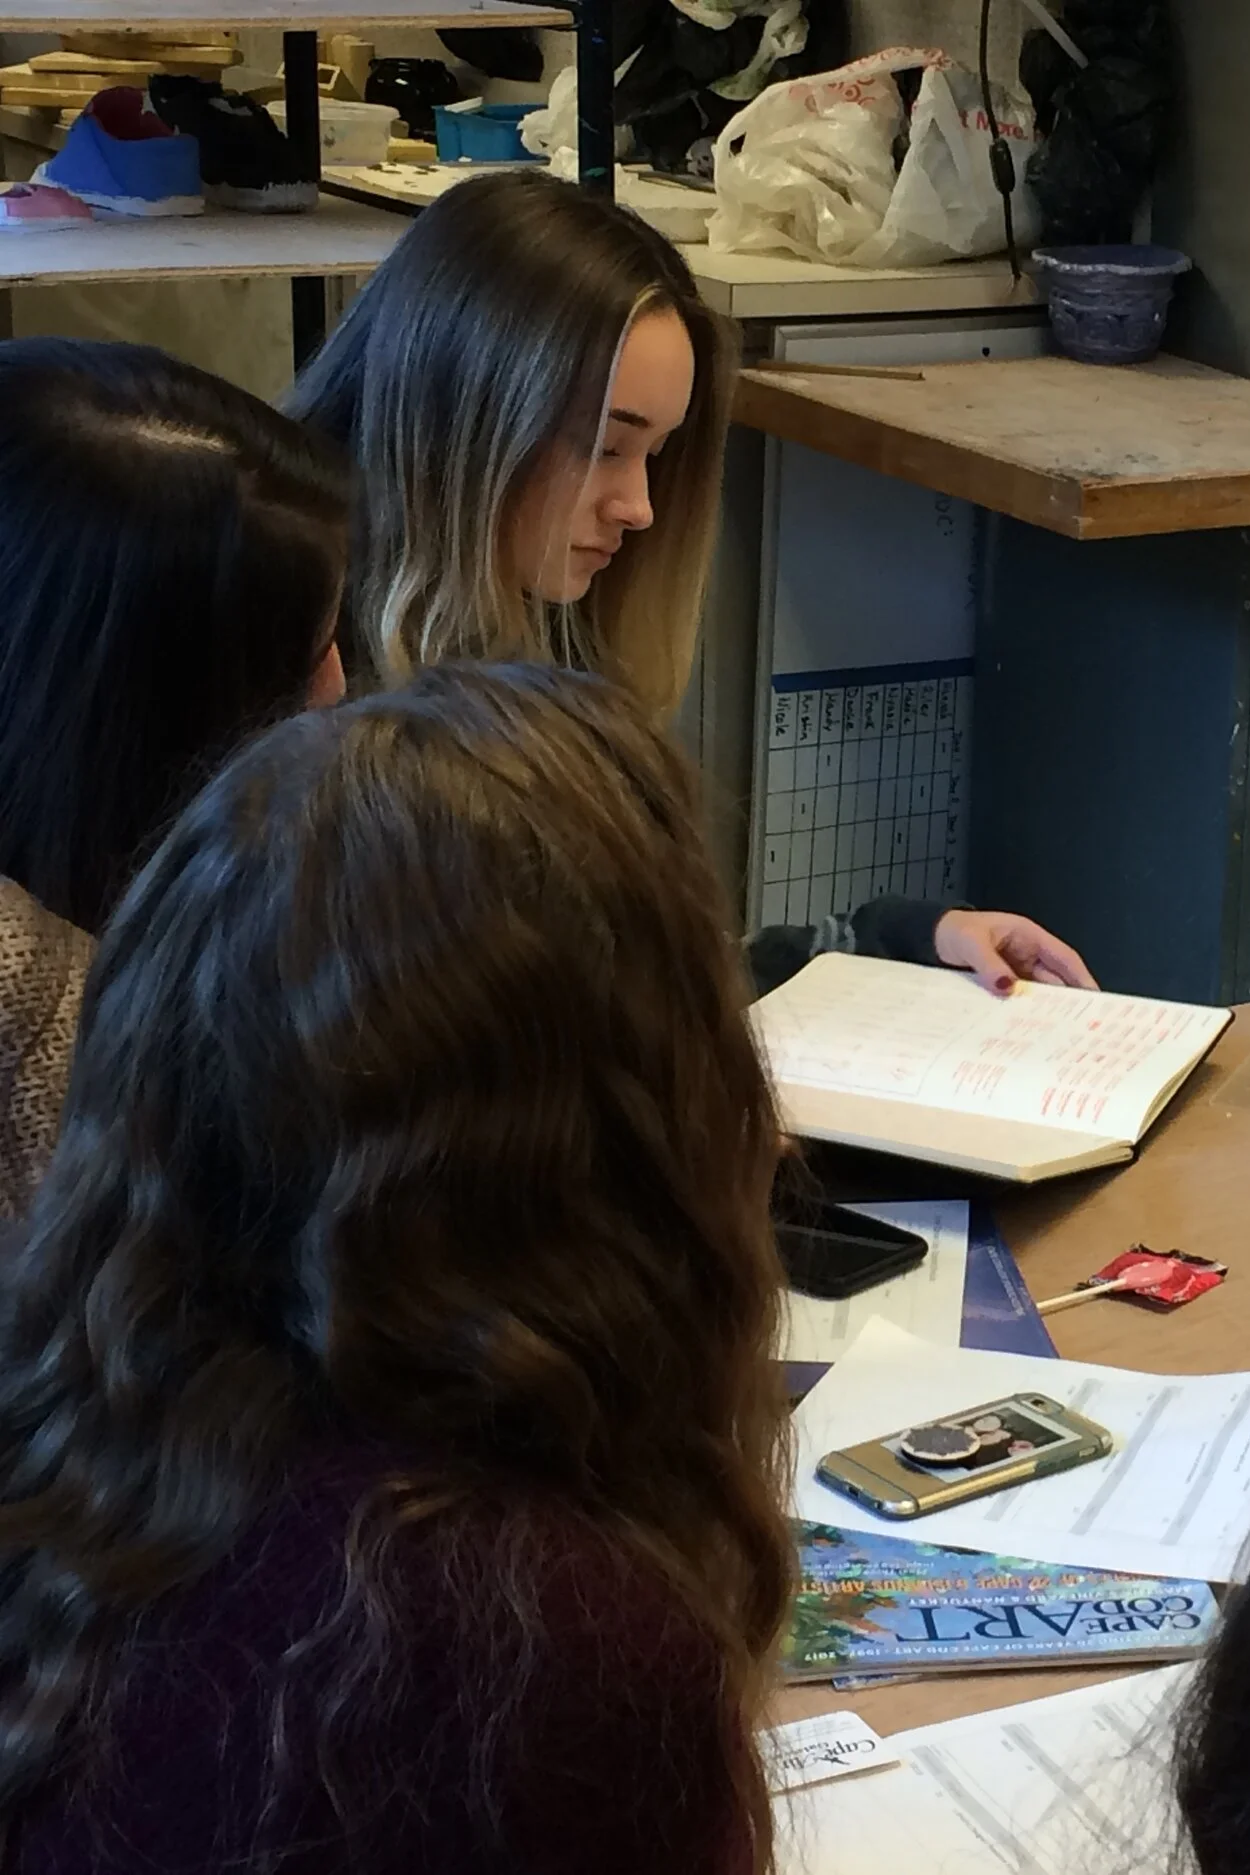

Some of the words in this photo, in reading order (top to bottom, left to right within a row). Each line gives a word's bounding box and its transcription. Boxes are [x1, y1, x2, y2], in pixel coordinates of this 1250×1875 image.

[976, 111, 1029, 140] Mre.
[775, 697, 790, 737] Nicole
[908, 1596, 1006, 1607] NANTUCKET
[1093, 1596, 1193, 1616] COD
[895, 1600, 1091, 1642] ART
[1079, 1614, 1201, 1635] CAPE
[895, 1647, 922, 1655] ART
[926, 1646, 959, 1655] COD
[963, 1644, 999, 1653] CAPE
[1026, 1641, 1071, 1650] YEARS
[804, 1651, 836, 1661] 2017
[824, 1739, 876, 1759] Cape
